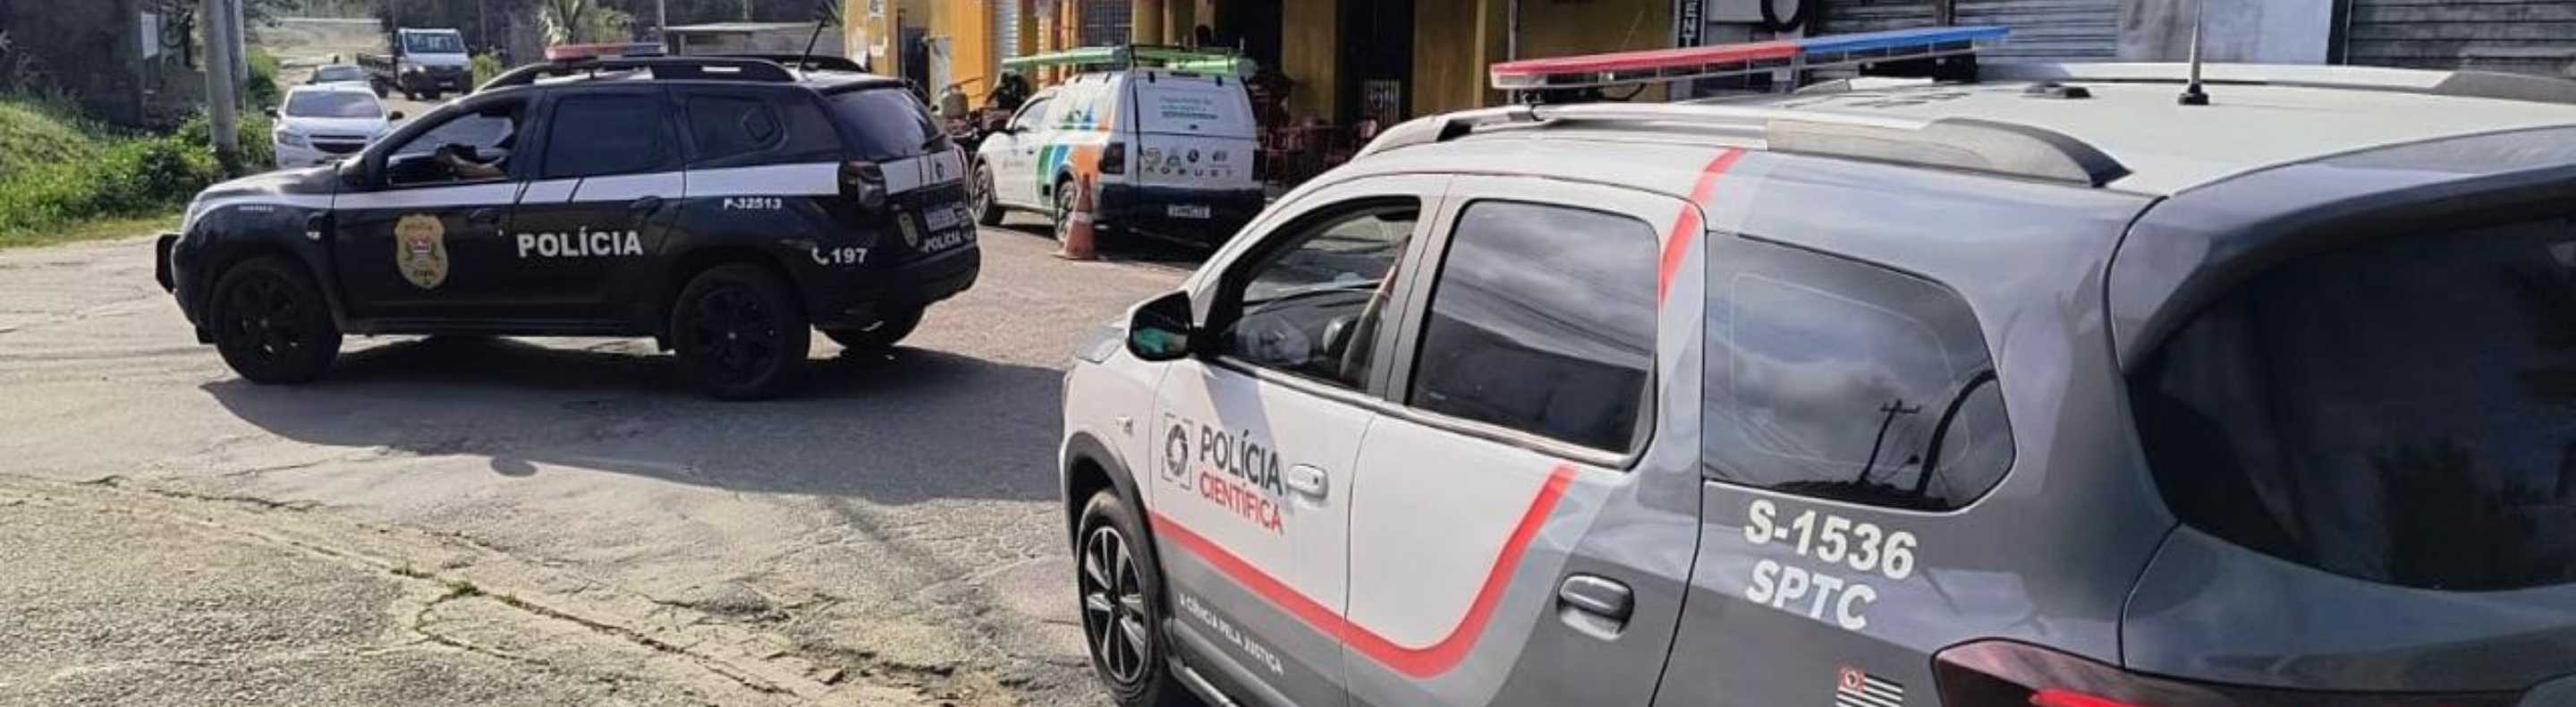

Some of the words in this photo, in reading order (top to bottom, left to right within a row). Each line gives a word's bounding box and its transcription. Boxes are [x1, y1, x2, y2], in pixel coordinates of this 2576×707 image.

[517, 226, 643, 258] POLÍCIA
[830, 247, 868, 264] 197
[1200, 424, 1283, 496] POLÍCIA
[1199, 471, 1284, 534] CIENTÍFICA
[1745, 498, 1917, 580] S-1536
[1745, 559, 1877, 631] SPTC
